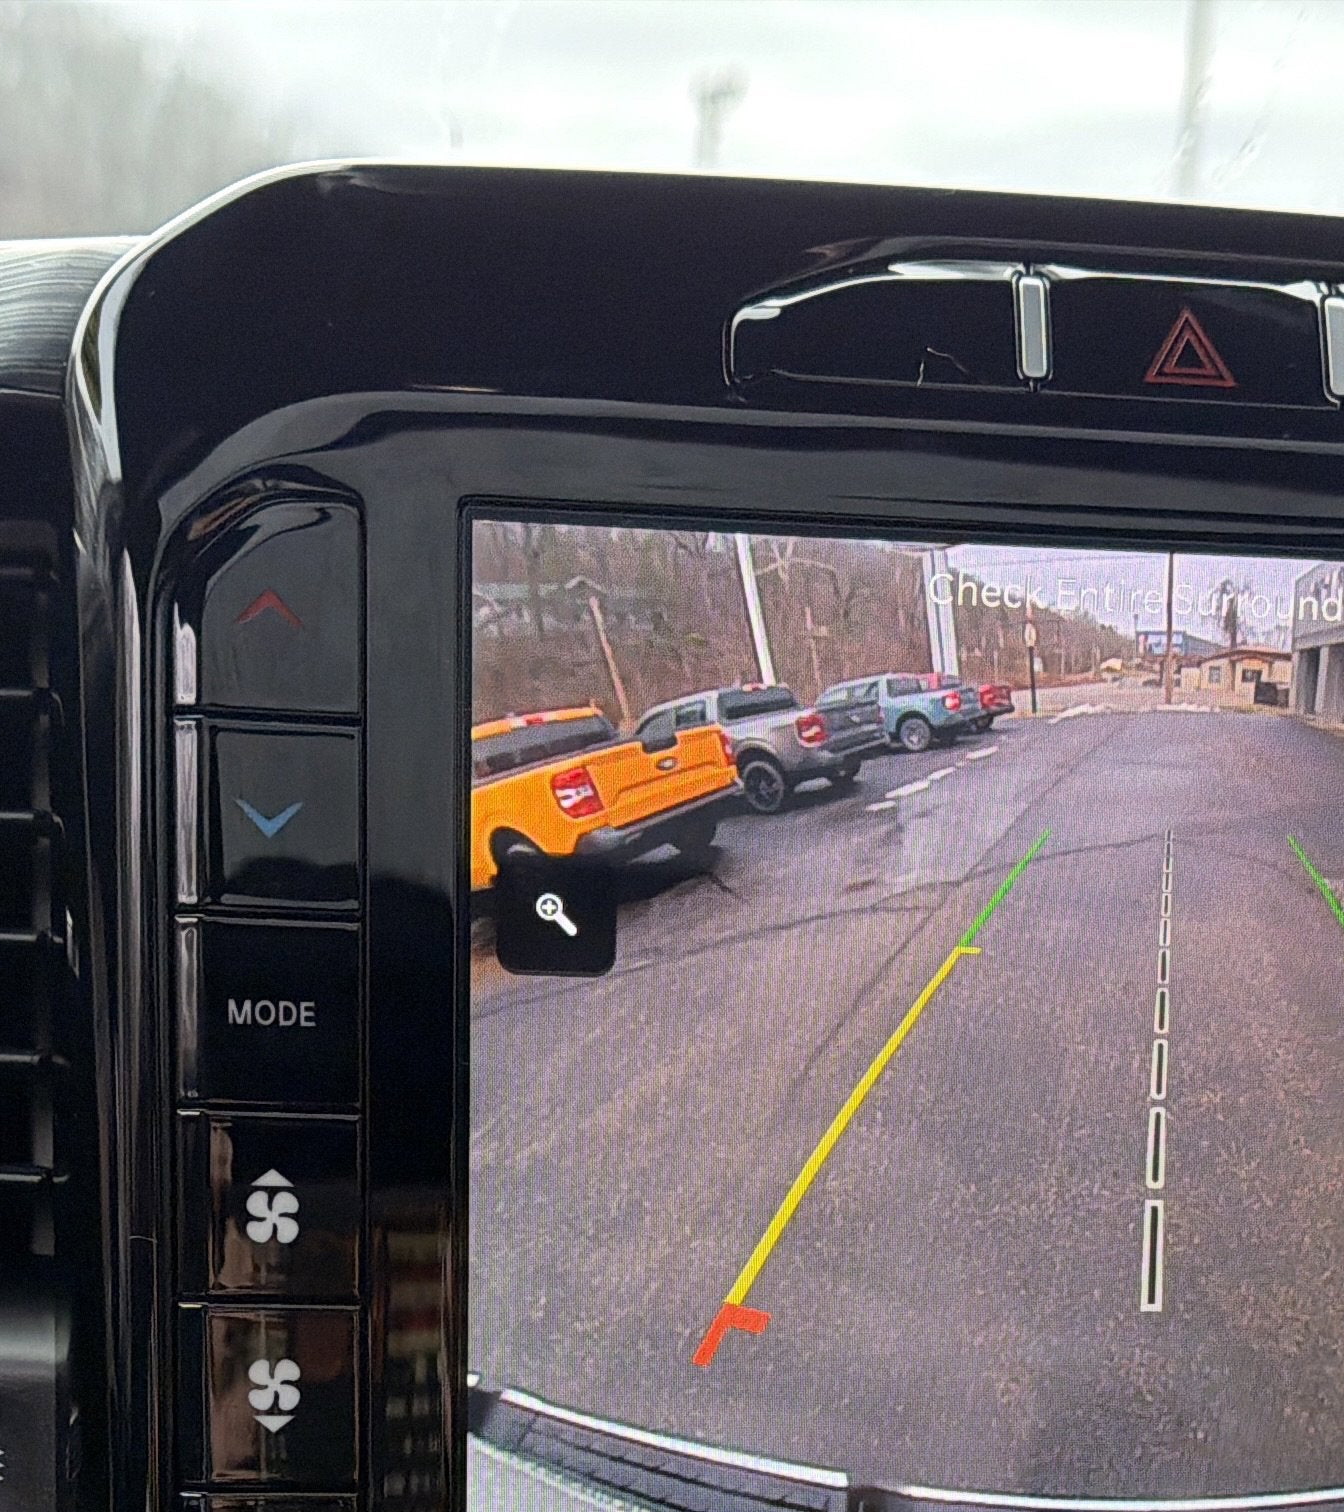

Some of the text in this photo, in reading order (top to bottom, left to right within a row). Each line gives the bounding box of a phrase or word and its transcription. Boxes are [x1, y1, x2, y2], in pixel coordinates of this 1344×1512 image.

[928, 572, 1043, 611] Check
[1057, 577, 1161, 616] Entire
[227, 998, 316, 1027] MODE
